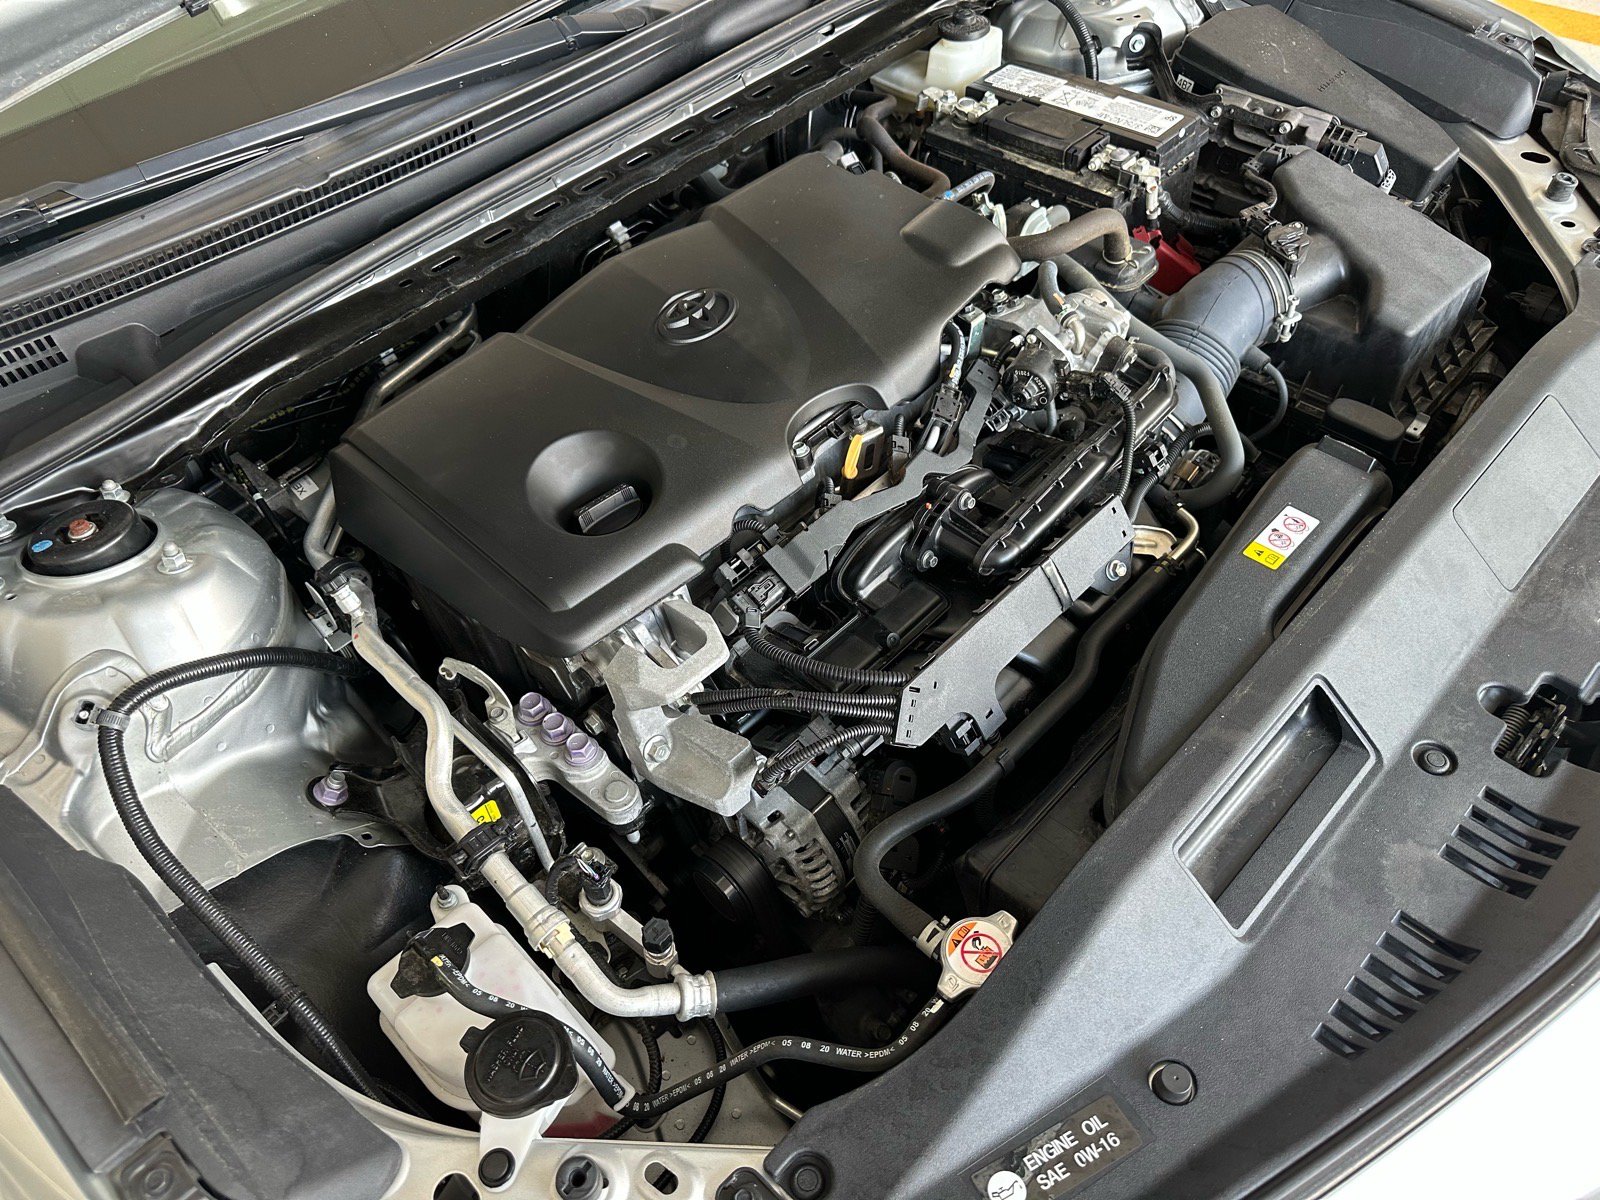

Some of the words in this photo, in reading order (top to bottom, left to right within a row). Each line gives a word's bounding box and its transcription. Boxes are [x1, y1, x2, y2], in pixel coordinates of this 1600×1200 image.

[1177, 78, 1193, 91] 4B7
[472, 988, 482, 996] 05
[506, 1001, 515, 1009] 20
[633, 1101, 640, 1111] 08
[644, 1102, 650, 1112] 20
[652, 1093, 669, 1108] WATER
[694, 1076, 702, 1086] 05
[729, 1050, 749, 1067] WATER
[781, 1039, 793, 1047] 05
[801, 1041, 812, 1050] 08
[819, 1044, 830, 1053] 20
[836, 1046, 862, 1058] WATER
[864, 1046, 896, 1058] >EPDM<
[898, 1034, 908, 1046] 05
[910, 1021, 920, 1032] 08
[921, 1007, 931, 1017] 20
[1022, 1130, 1079, 1172] ENGINE
[1081, 1115, 1109, 1136] OIL
[1036, 1162, 1071, 1190] SAE
[1073, 1132, 1121, 1168] 0W-16
